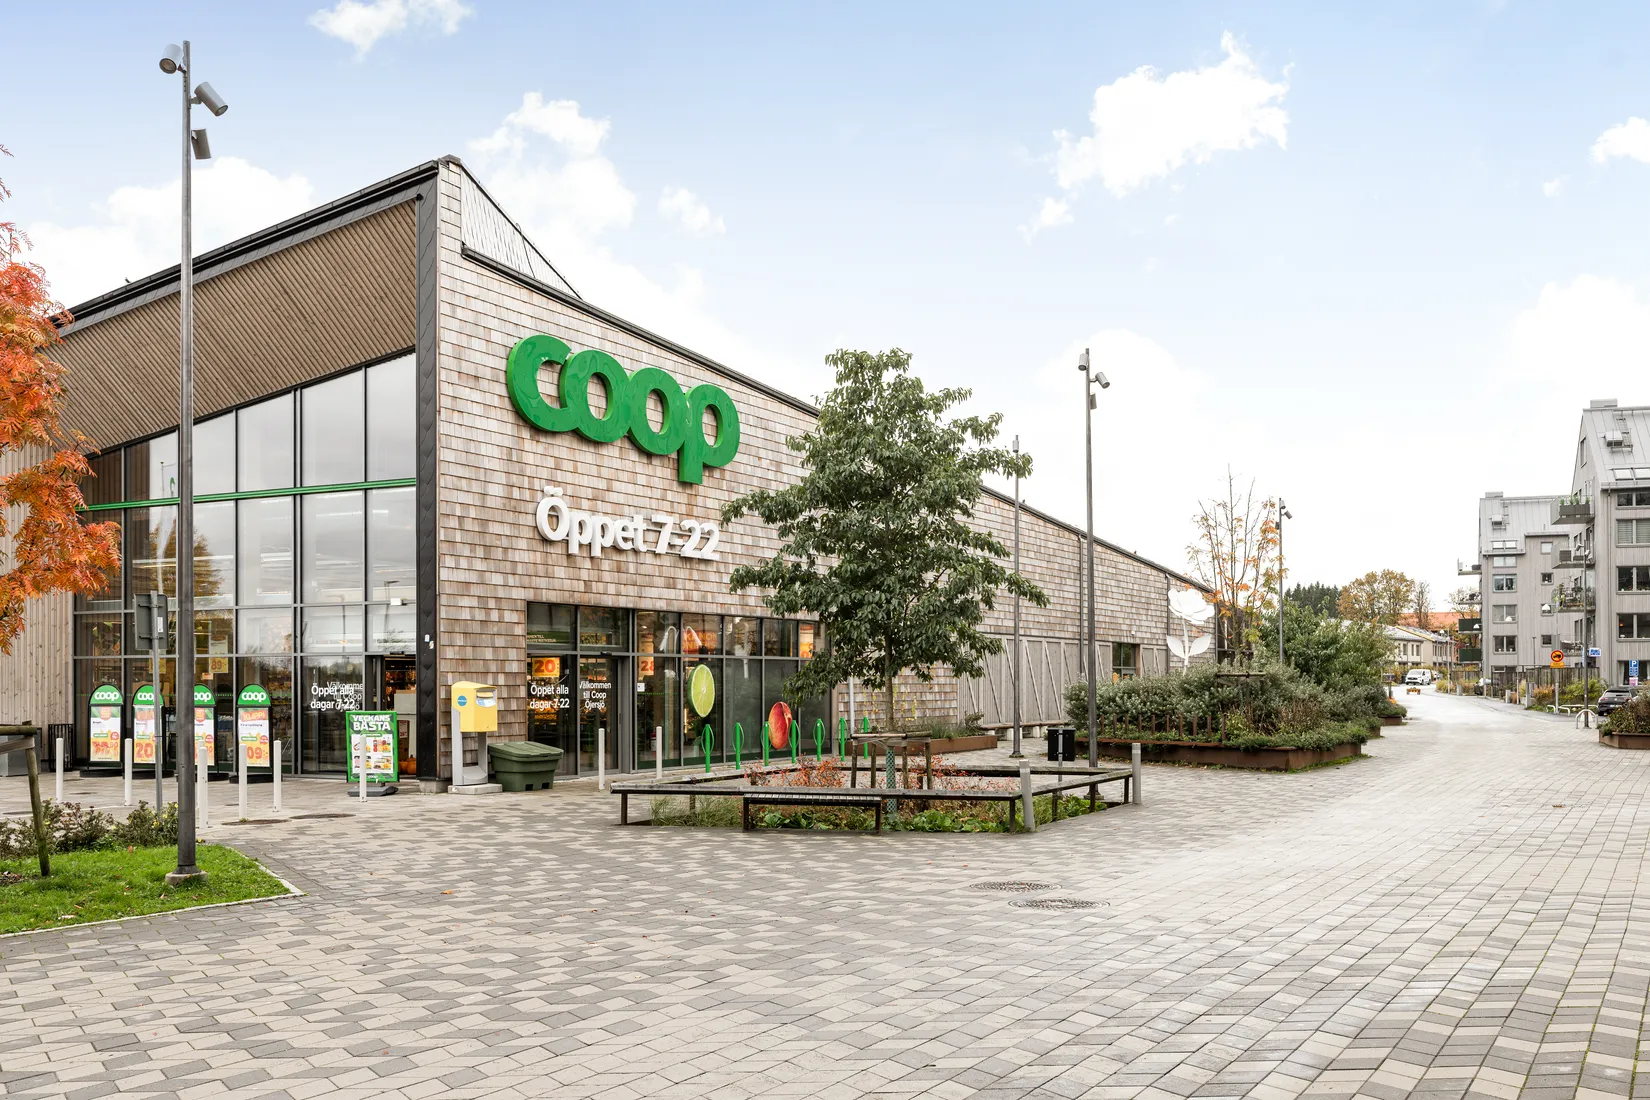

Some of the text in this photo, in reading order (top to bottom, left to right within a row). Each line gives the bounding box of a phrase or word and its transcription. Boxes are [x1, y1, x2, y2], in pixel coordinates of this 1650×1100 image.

[506, 334, 740, 485] coop
[535, 485, 720, 562] Öppet 7-22
[311, 682, 355, 697] Öppet alla
[530, 682, 569, 697] Öppet alla
[579, 680, 612, 690] Välkommen
[94, 691, 119, 702] coop
[137, 692, 154, 702] coo
[194, 692, 212, 703] oop
[241, 691, 267, 703] coop
[591, 691, 607, 700] Coop
[310, 699, 355, 712] dagar 7-22
[529, 698, 570, 712] dagar 7-22
[584, 698, 605, 710] Öjersjö
[353, 714, 391, 722] VECKANS
[353, 720, 391, 731] BÄSTA
